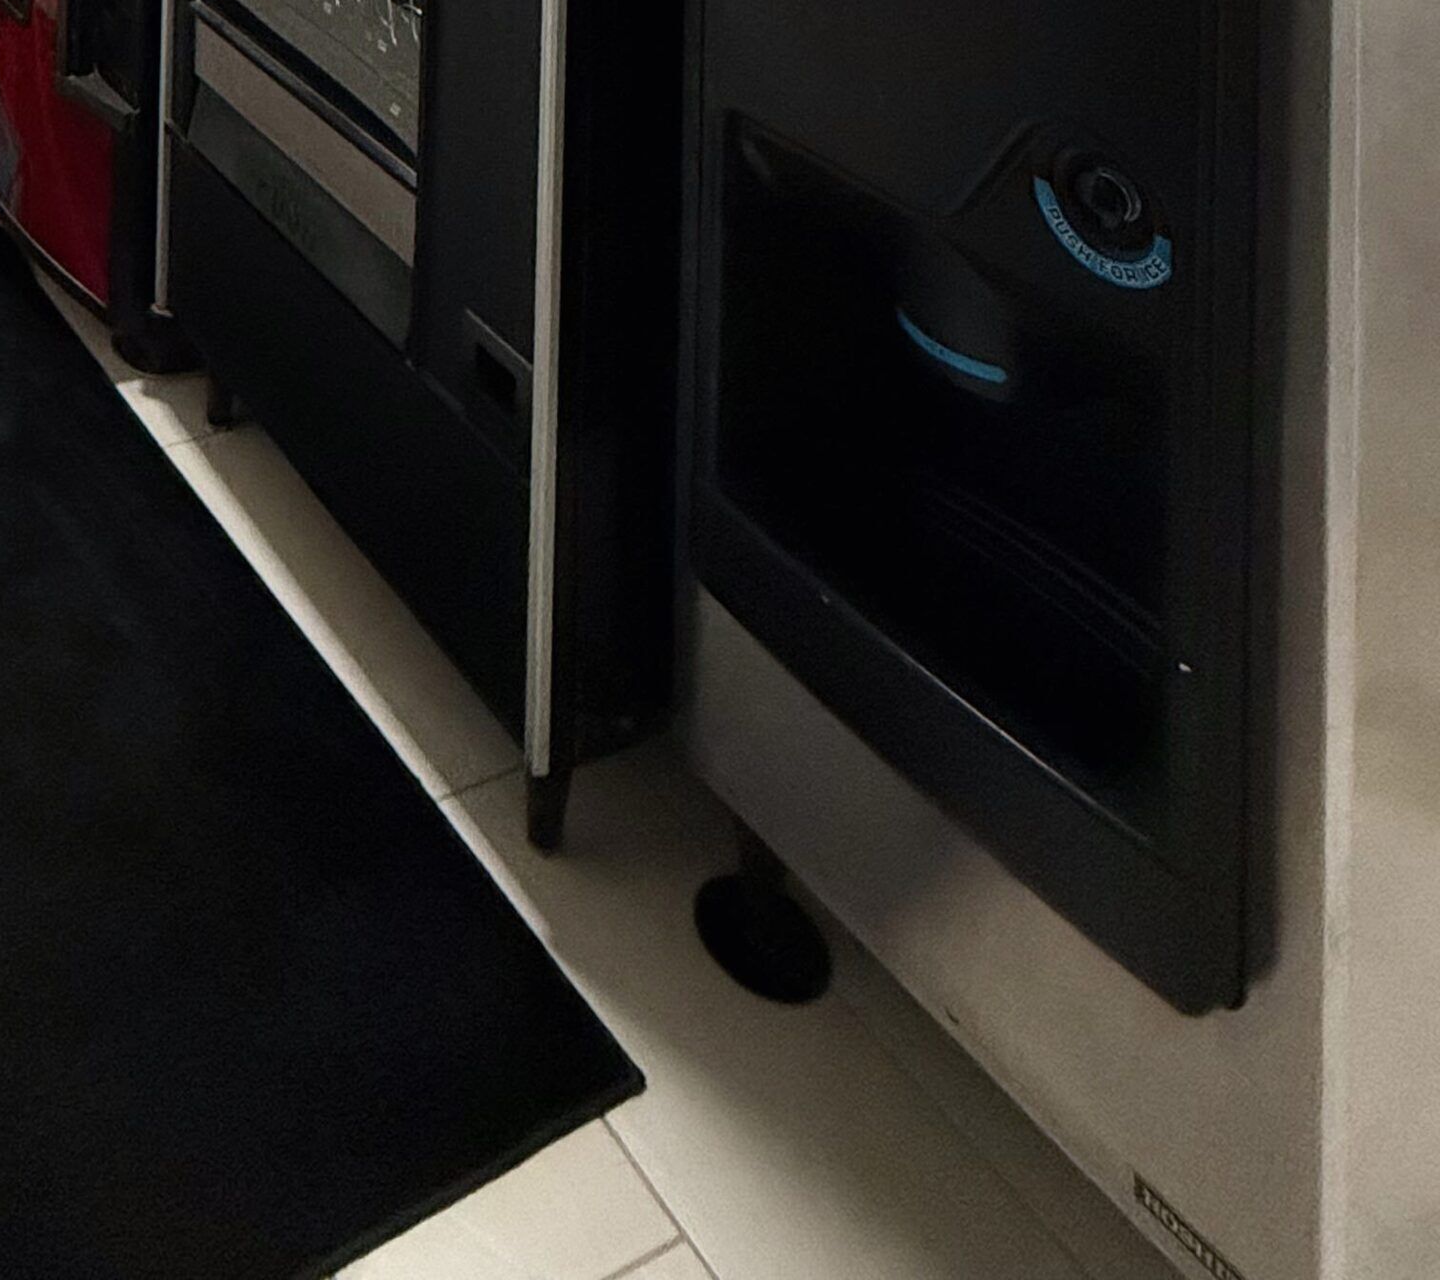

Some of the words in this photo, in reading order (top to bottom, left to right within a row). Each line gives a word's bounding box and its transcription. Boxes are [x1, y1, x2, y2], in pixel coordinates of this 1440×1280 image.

[1048, 205, 1093, 262] PUSH
[1099, 259, 1138, 284] FOR
[1142, 257, 1168, 283] ICE
